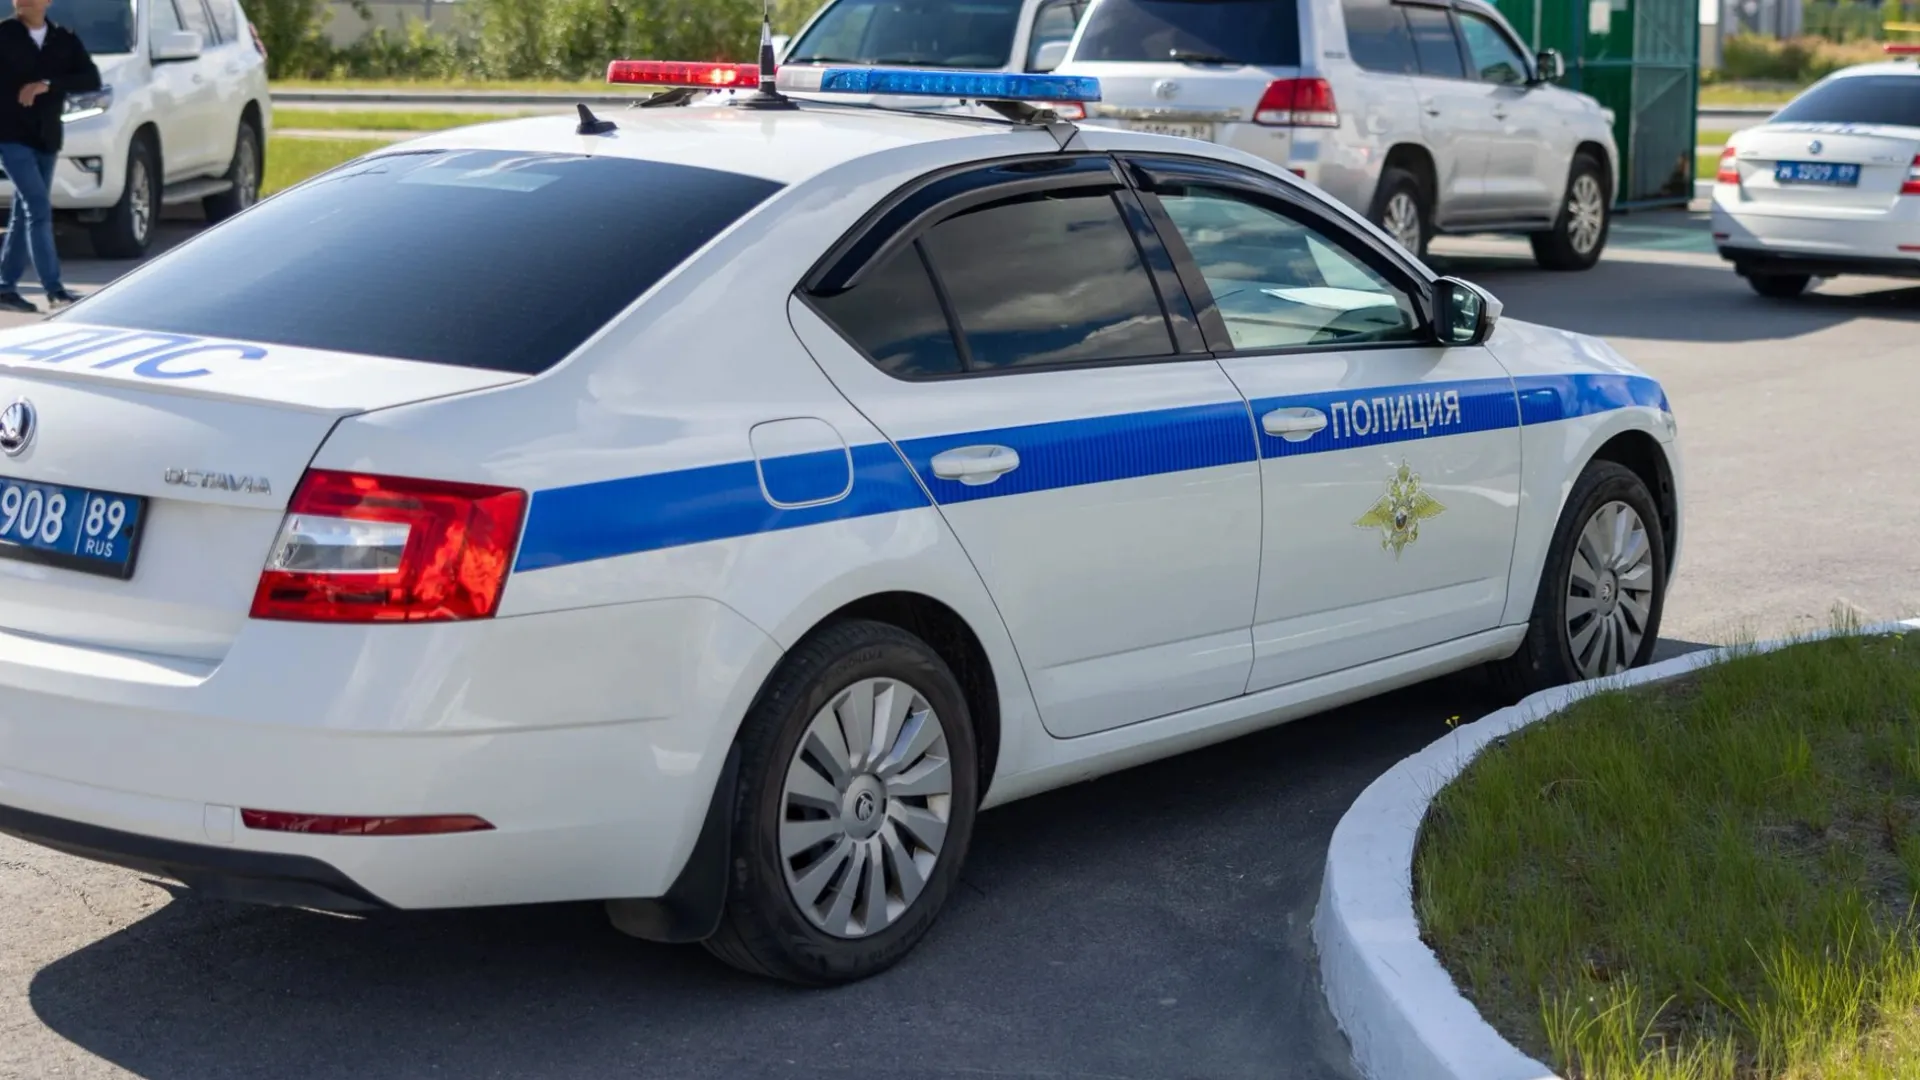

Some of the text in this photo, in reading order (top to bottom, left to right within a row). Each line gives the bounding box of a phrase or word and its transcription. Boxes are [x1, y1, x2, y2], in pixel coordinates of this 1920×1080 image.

[0, 328, 268, 379] ДПС
[1330, 390, 1461, 439] ПОЛИЦИЯ
[164, 466, 272, 496] OCTAVIA
[86, 498, 126, 539] 89
[86, 538, 113, 557] RUS
